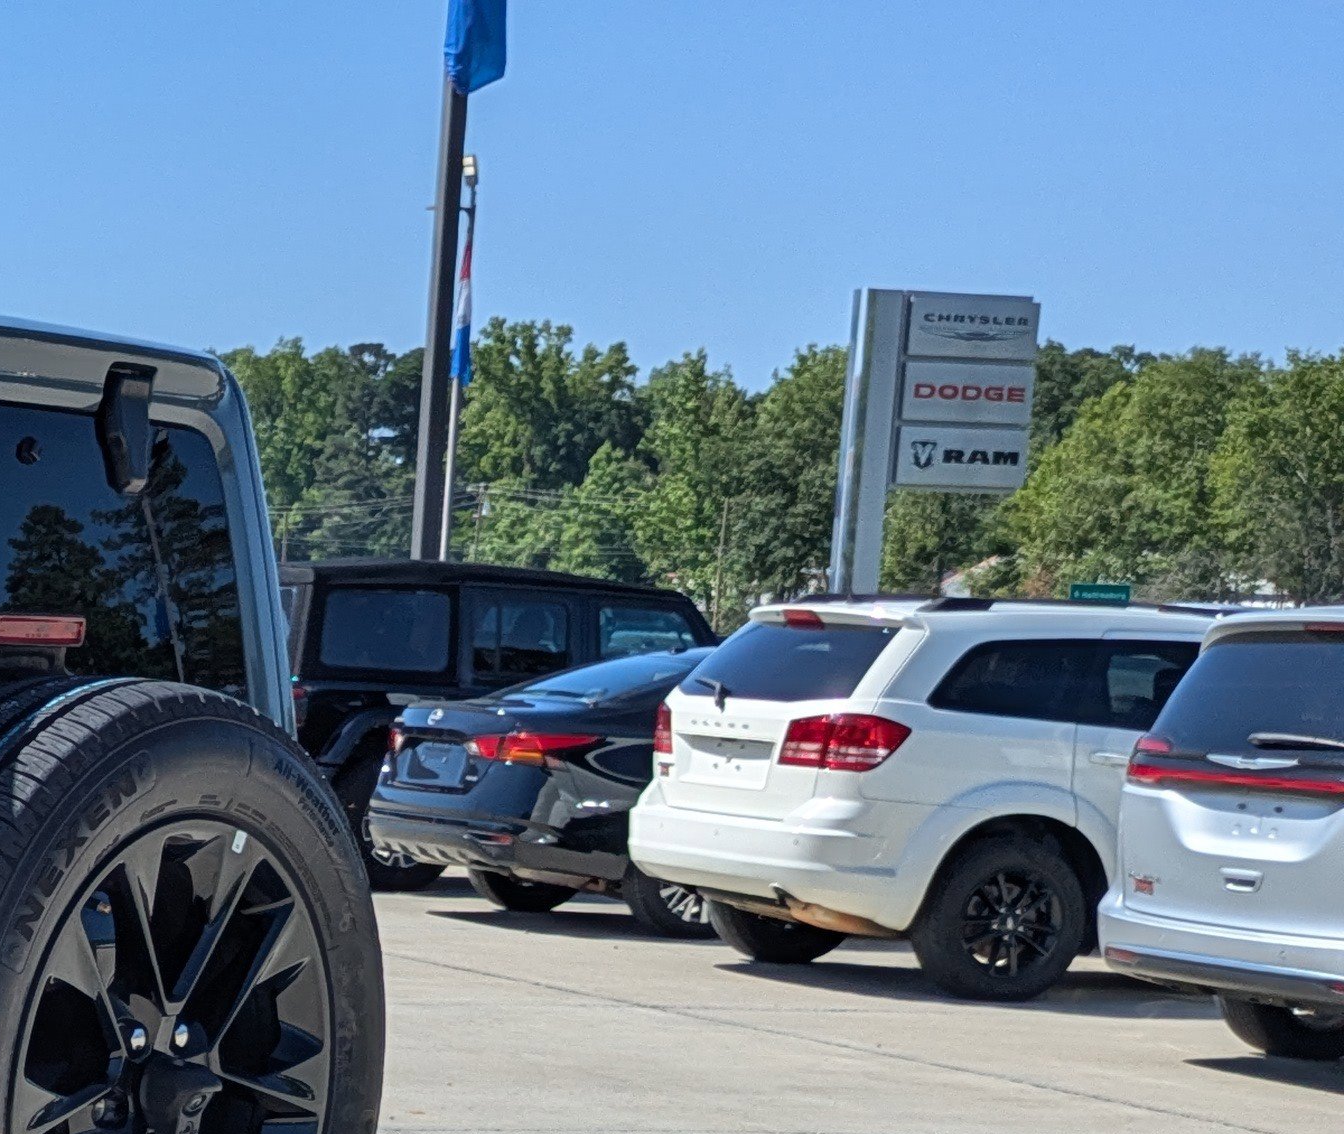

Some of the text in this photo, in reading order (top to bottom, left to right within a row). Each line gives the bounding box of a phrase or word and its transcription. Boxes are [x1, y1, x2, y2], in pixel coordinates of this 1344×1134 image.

[922, 312, 1029, 326] CHRYSLER
[913, 383, 1026, 403] DODGE
[941, 449, 1020, 466] RAM
[274, 758, 340, 836] All-Weather
[13, 767, 138, 943] NEXEN
